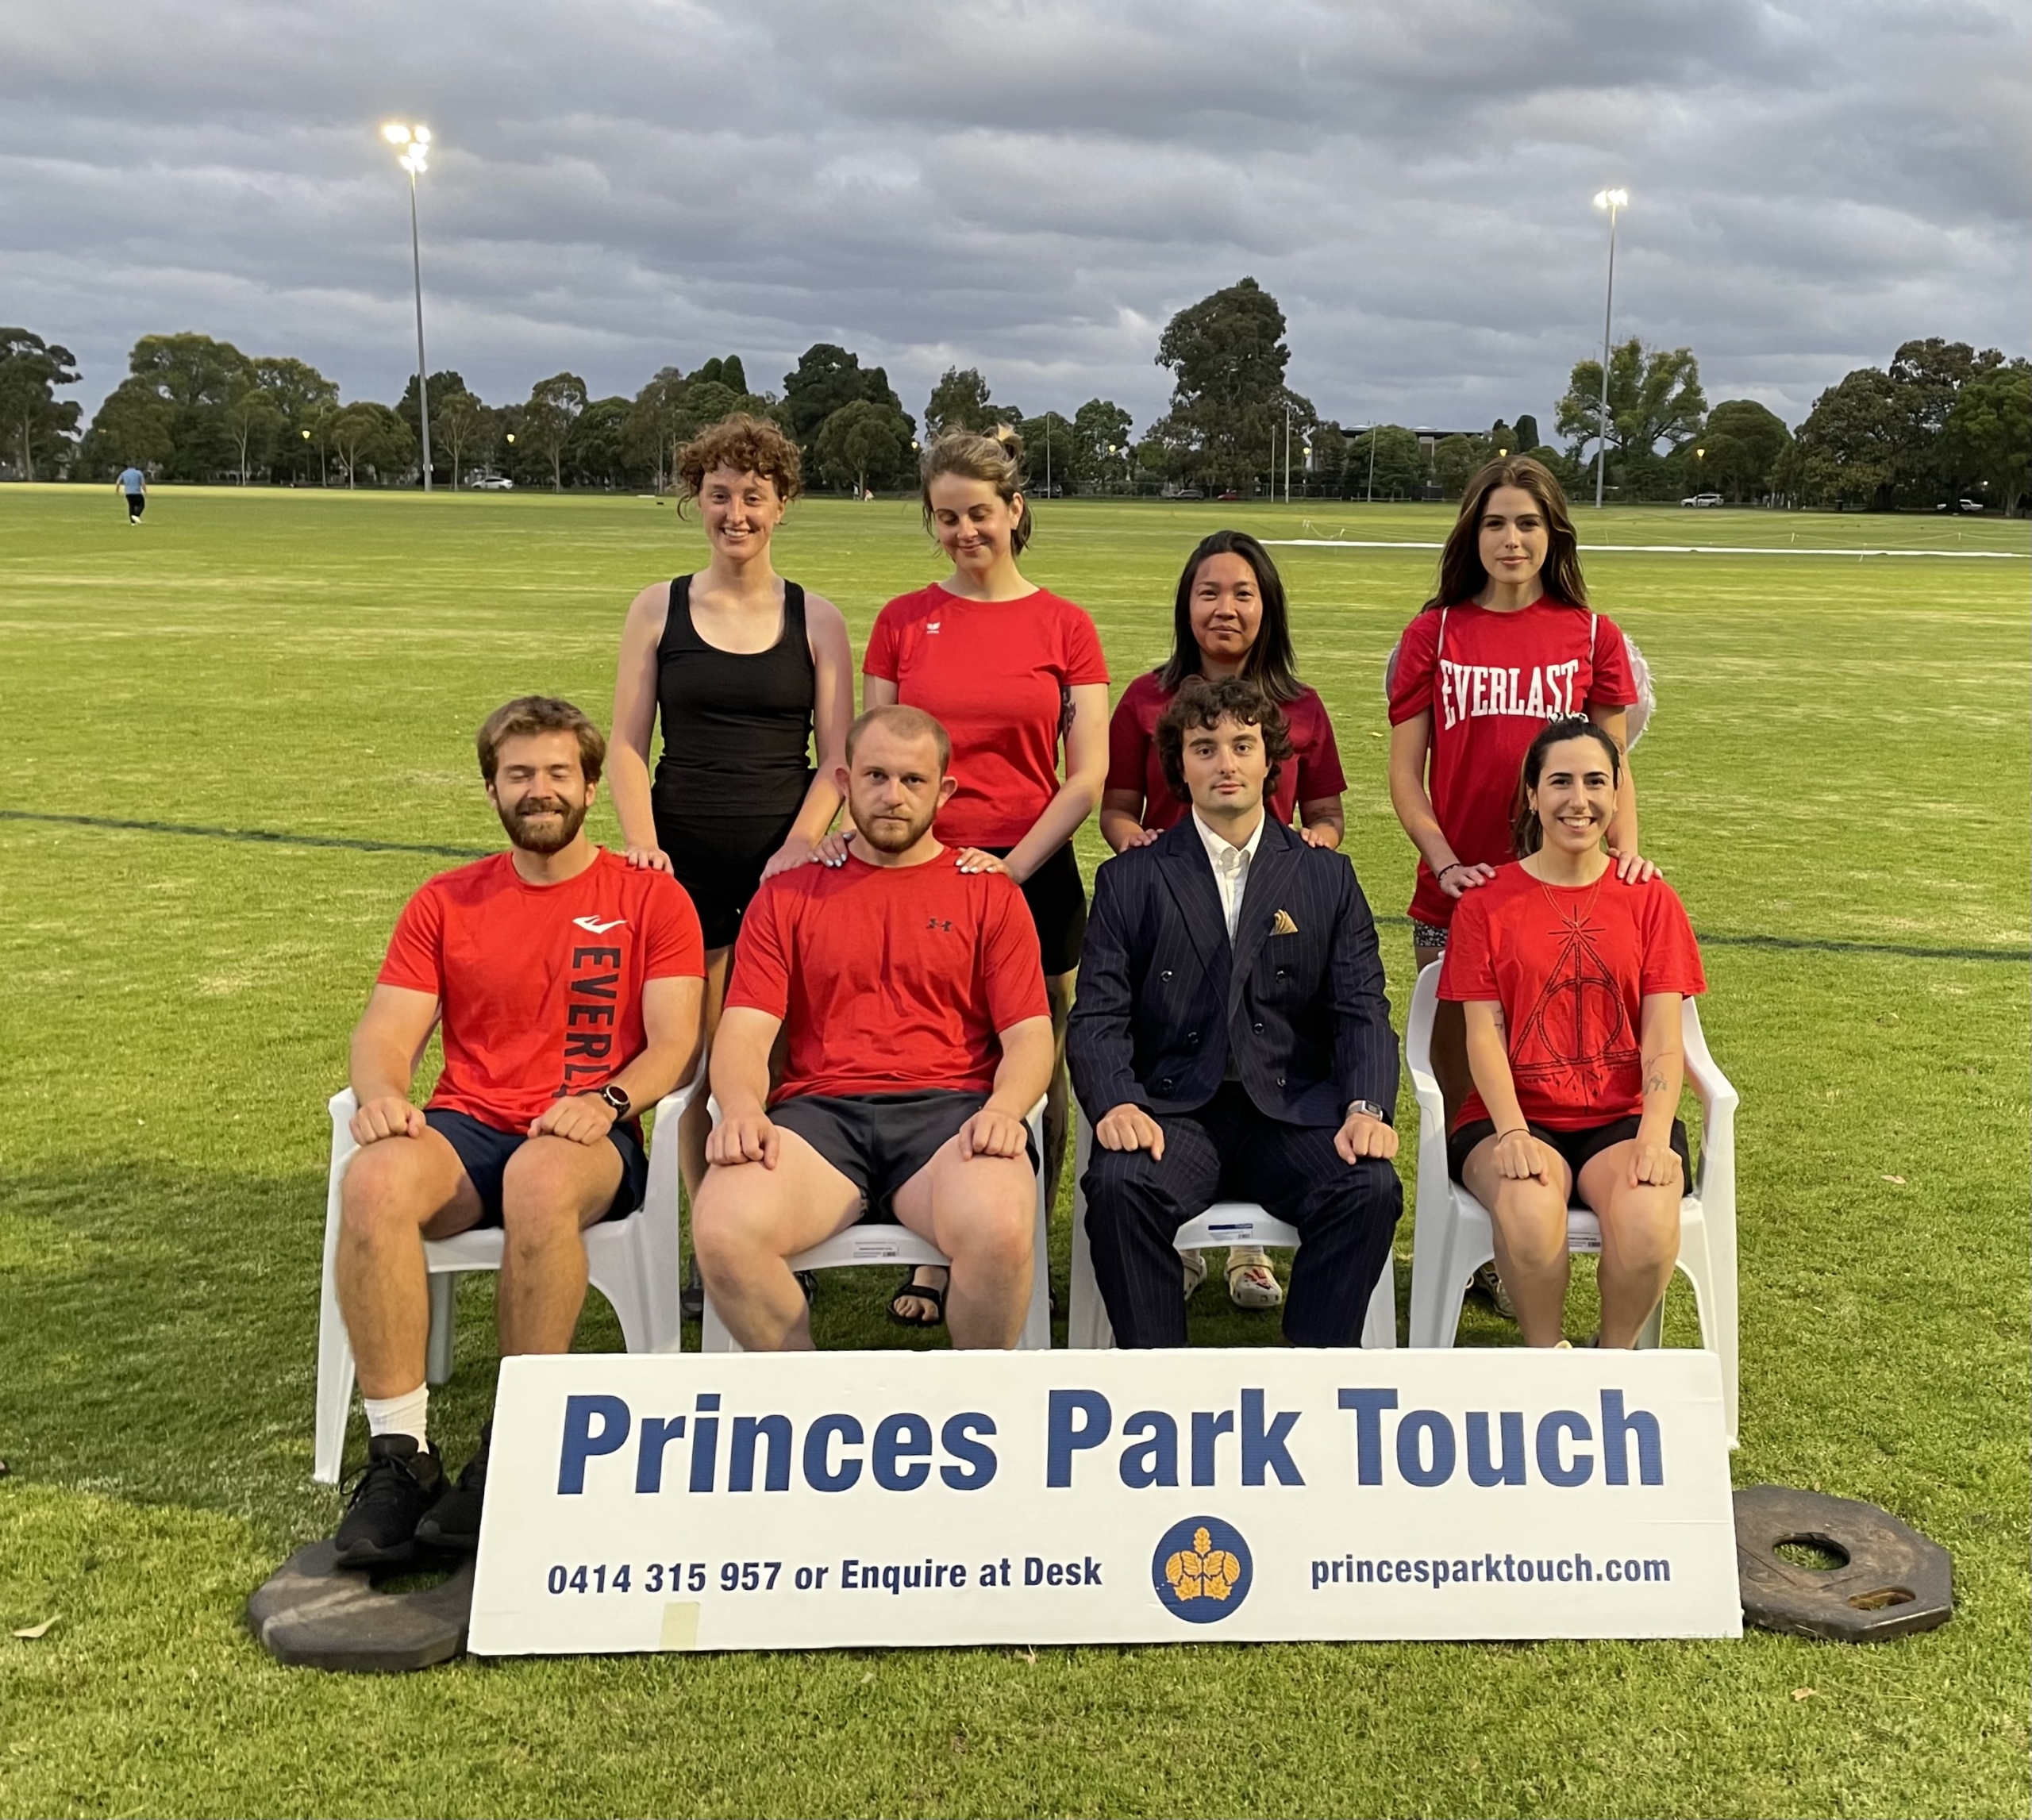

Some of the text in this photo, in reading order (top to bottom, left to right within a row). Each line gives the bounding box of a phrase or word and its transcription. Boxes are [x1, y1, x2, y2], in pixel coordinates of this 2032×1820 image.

[1440, 659, 1579, 731] EVERLAST
[556, 1388, 1664, 1495] Princes Park Touch
[548, 1556, 1103, 1595] 0414 315 957 or Enquire at Desk
[1311, 1553, 1670, 1590] princesparktouch.com
